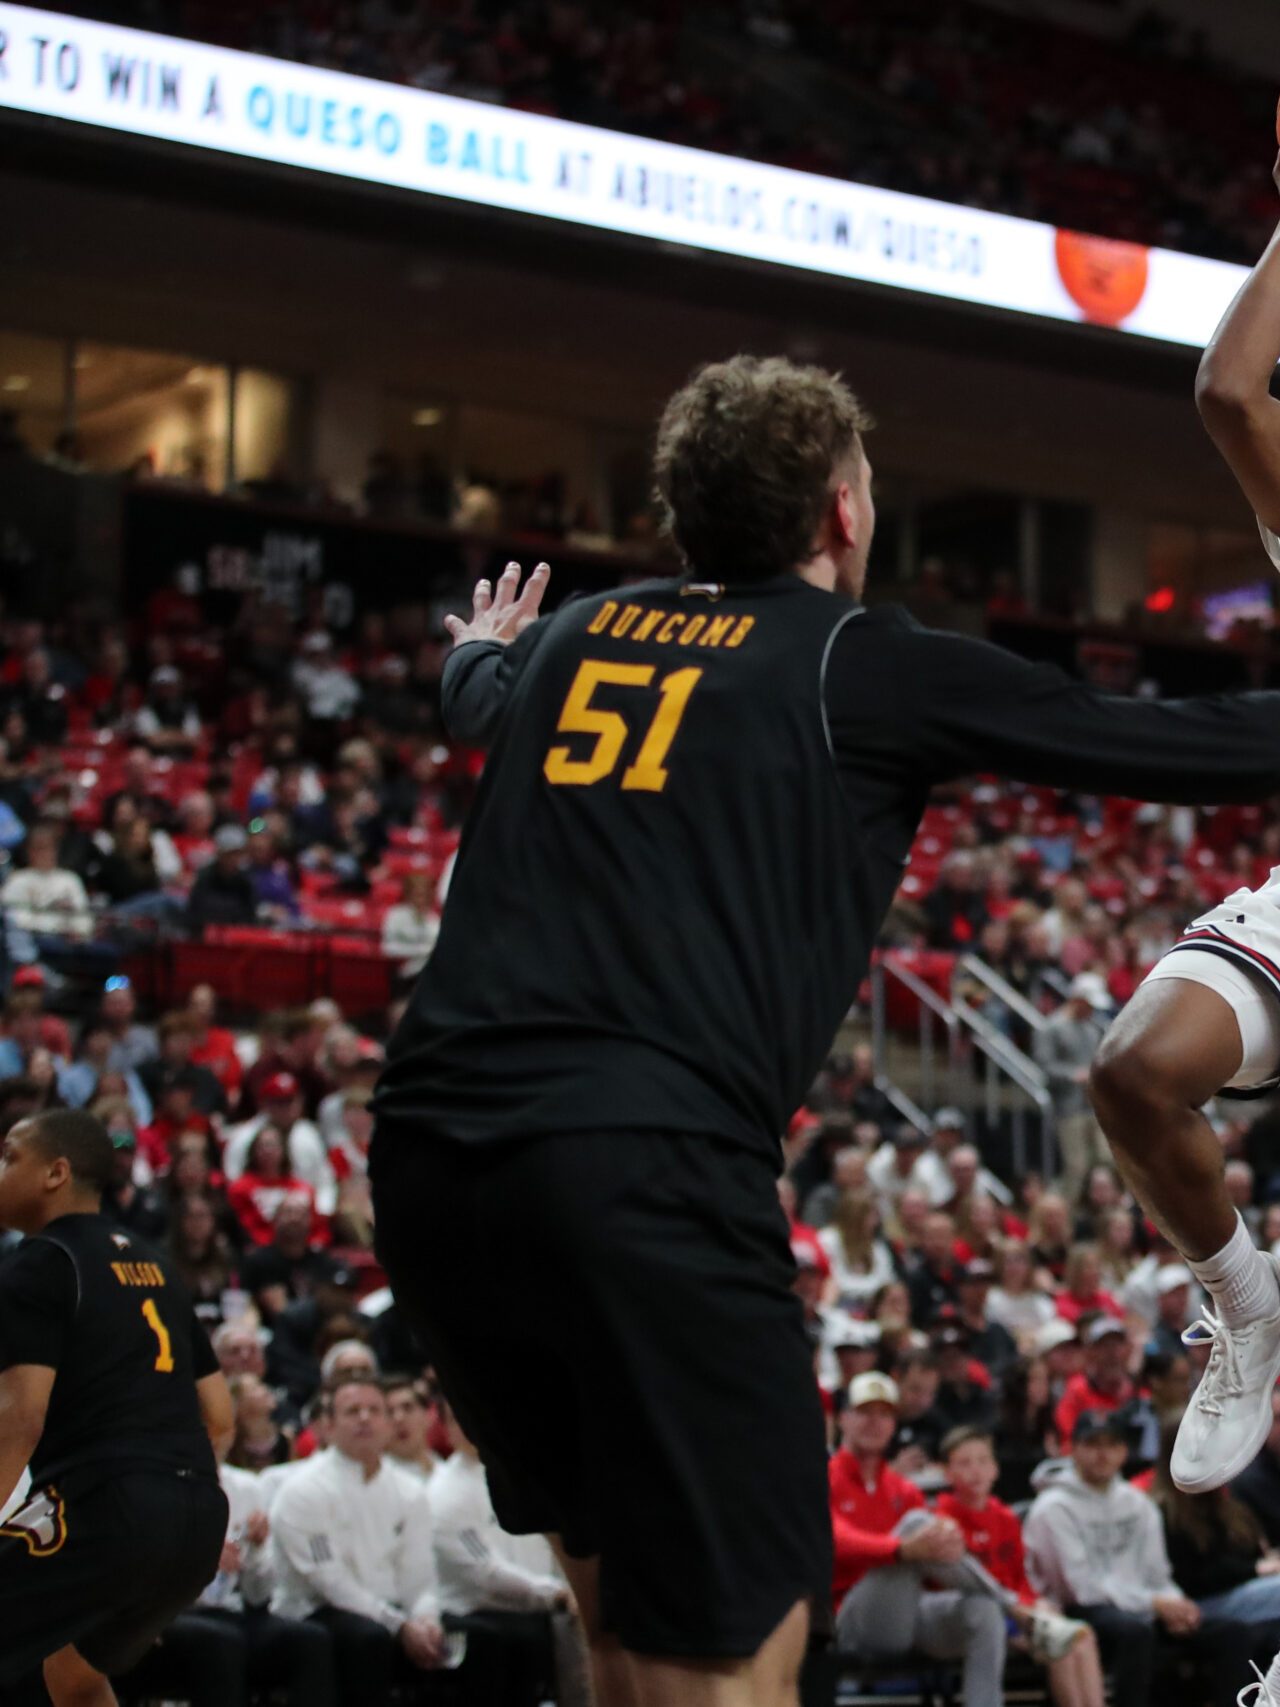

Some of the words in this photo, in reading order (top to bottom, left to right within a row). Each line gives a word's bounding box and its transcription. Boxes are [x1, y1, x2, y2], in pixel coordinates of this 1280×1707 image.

[30, 35, 82, 93] TO
[100, 47, 184, 115] WIN
[199, 71, 227, 125] A
[243, 80, 403, 158] QUESO
[422, 118, 532, 185] BALL
[553, 147, 592, 197] AT
[586, 600, 756, 648] DUNCOMB
[543, 658, 703, 792] 51
[110, 1262, 165, 1286] WILSON
[141, 1299, 174, 1372] 1
